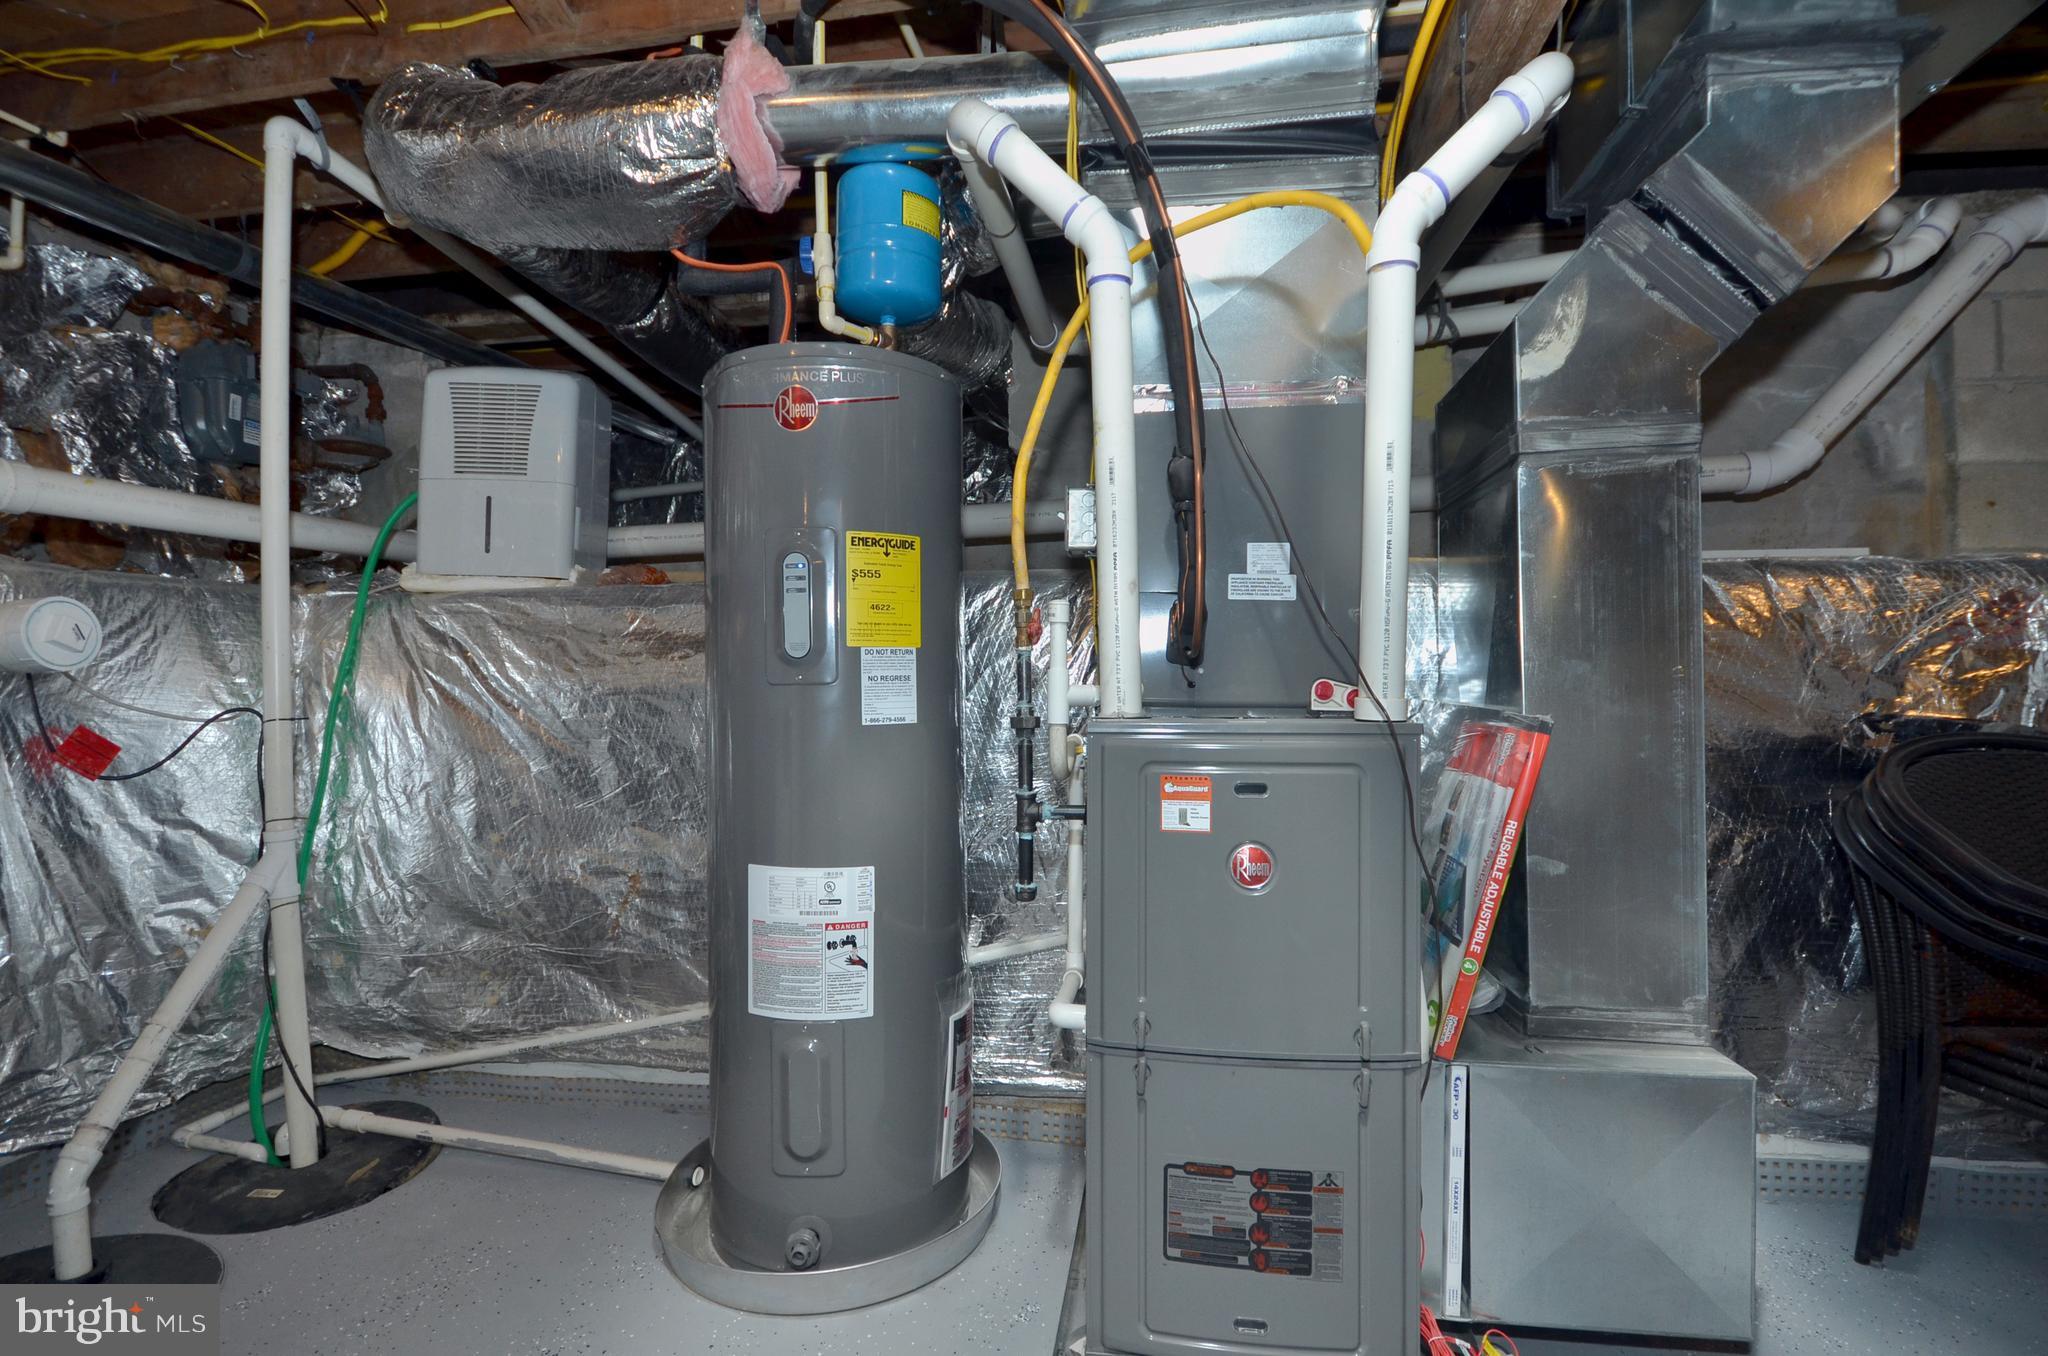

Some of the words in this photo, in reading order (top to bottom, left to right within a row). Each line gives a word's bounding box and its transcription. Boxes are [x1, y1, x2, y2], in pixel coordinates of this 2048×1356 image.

[831, 371, 864, 383] PLUS
[778, 387, 815, 424] Rheem
[851, 536, 916, 551] ENERGYGUIDE
[1385, 539, 1393, 560] PPFA
[851, 568, 881, 579] $555
[864, 648, 875, 656] DO
[875, 648, 888, 656] NOT
[889, 648, 914, 656] RETURN
[880, 674, 912, 682] REGRESE
[1492, 819, 1518, 880] REUSABLE
[1236, 847, 1270, 881] Rheem
[1470, 880, 1500, 954] ADJUSTABLE
[835, 921, 867, 931] DANGER
